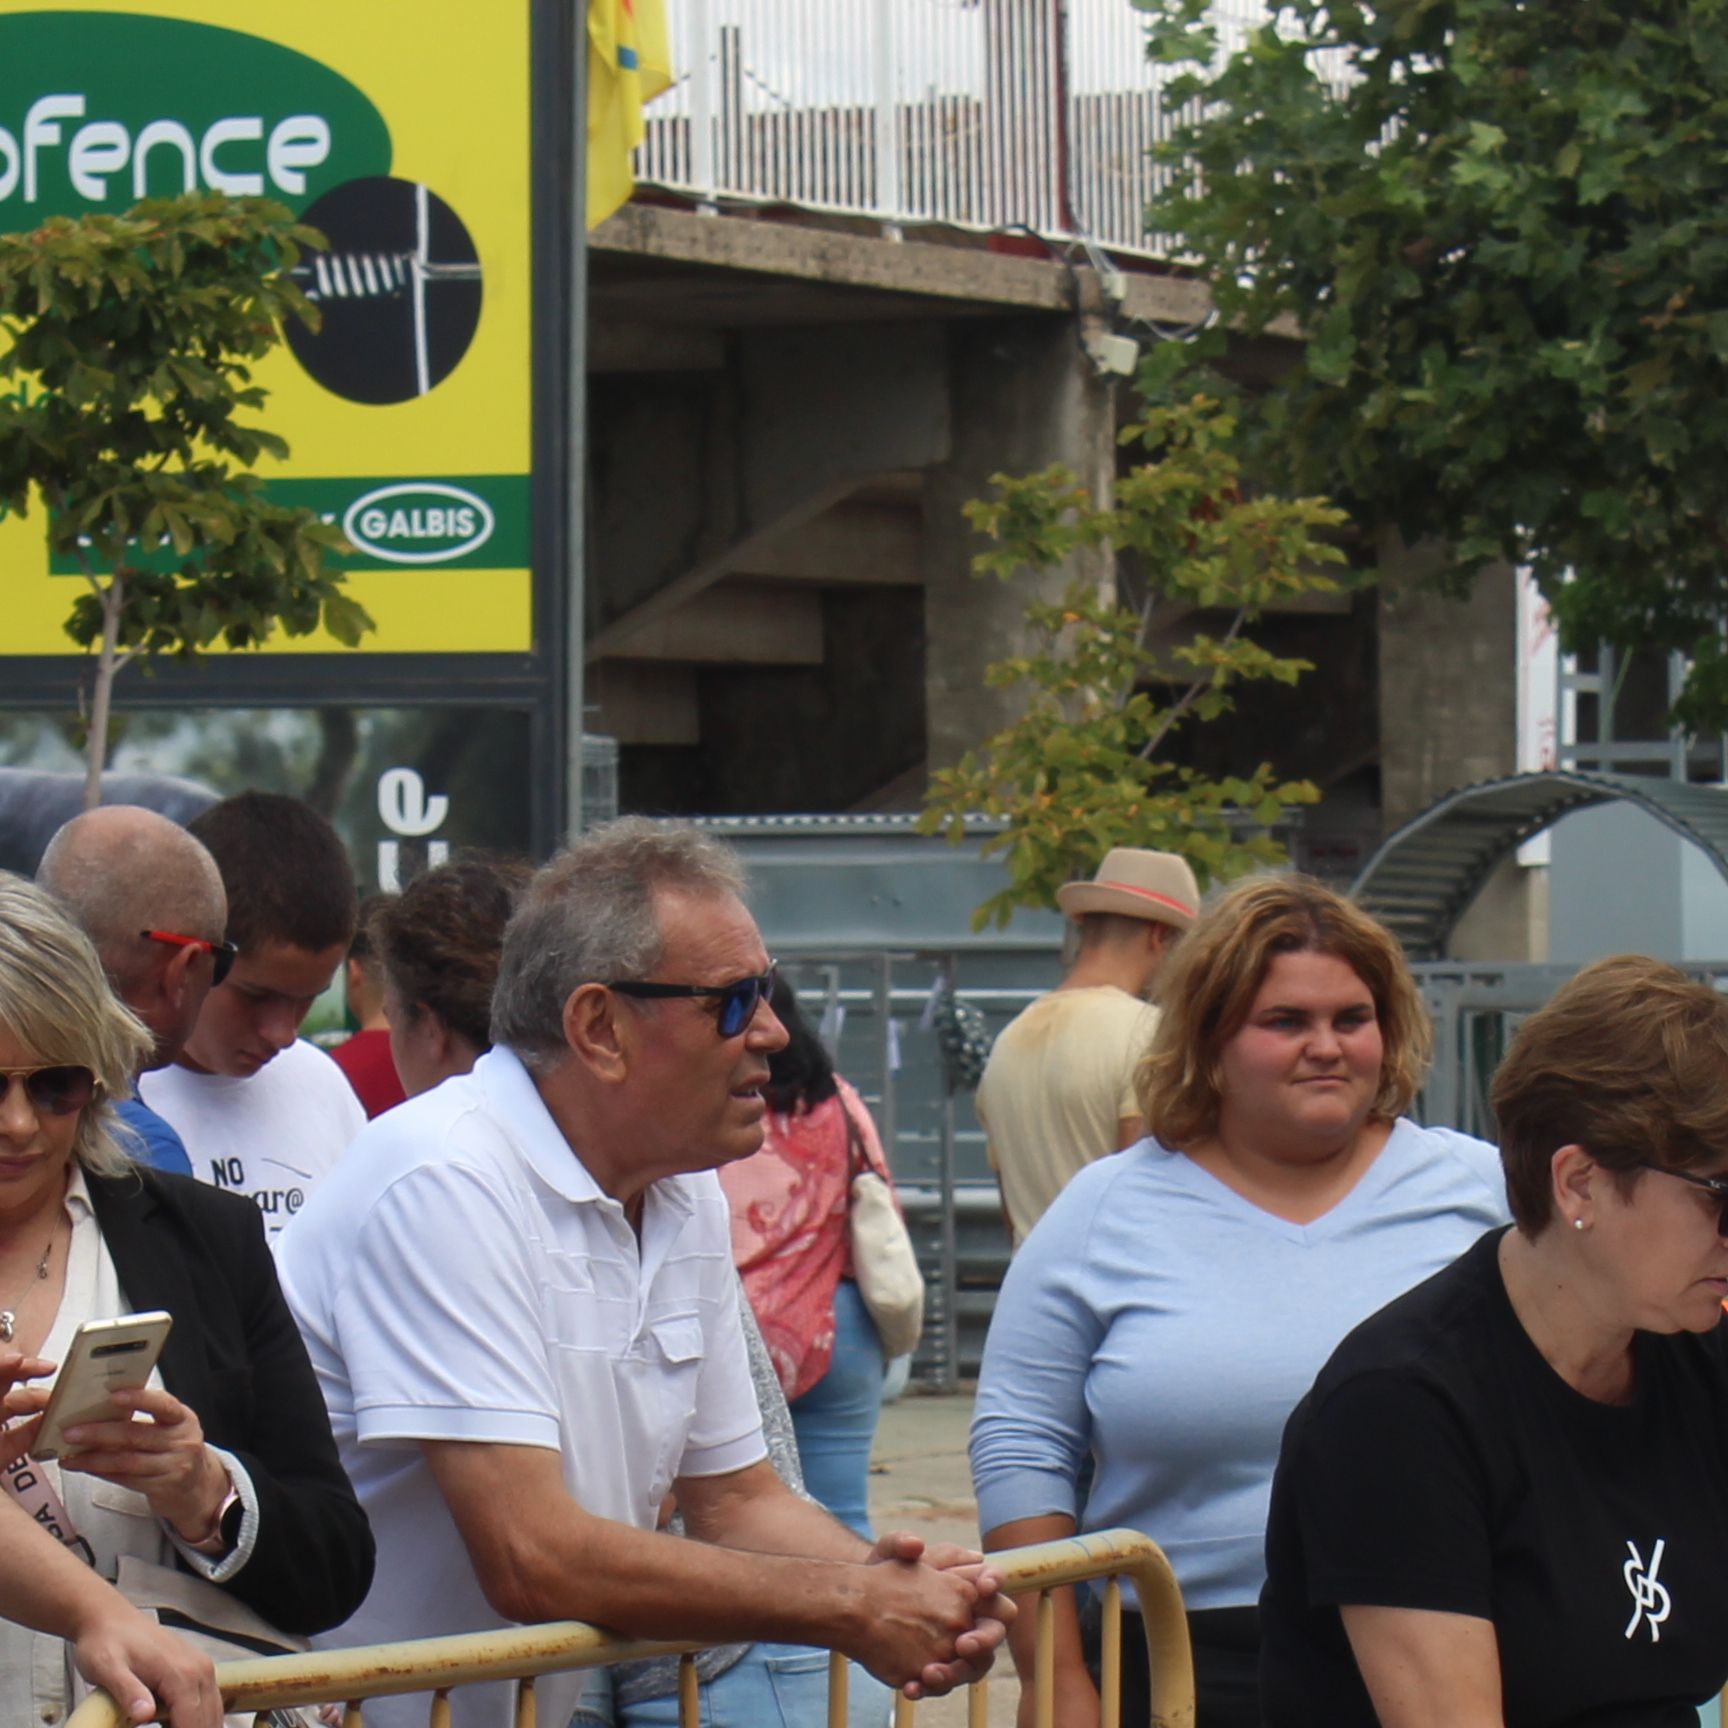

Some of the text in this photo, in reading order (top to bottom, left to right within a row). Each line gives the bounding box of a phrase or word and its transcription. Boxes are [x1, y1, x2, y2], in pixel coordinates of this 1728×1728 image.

[359, 506, 477, 541] GALBIS
[210, 1156, 246, 1188] NO
[248, 1187, 305, 1216] ar@
